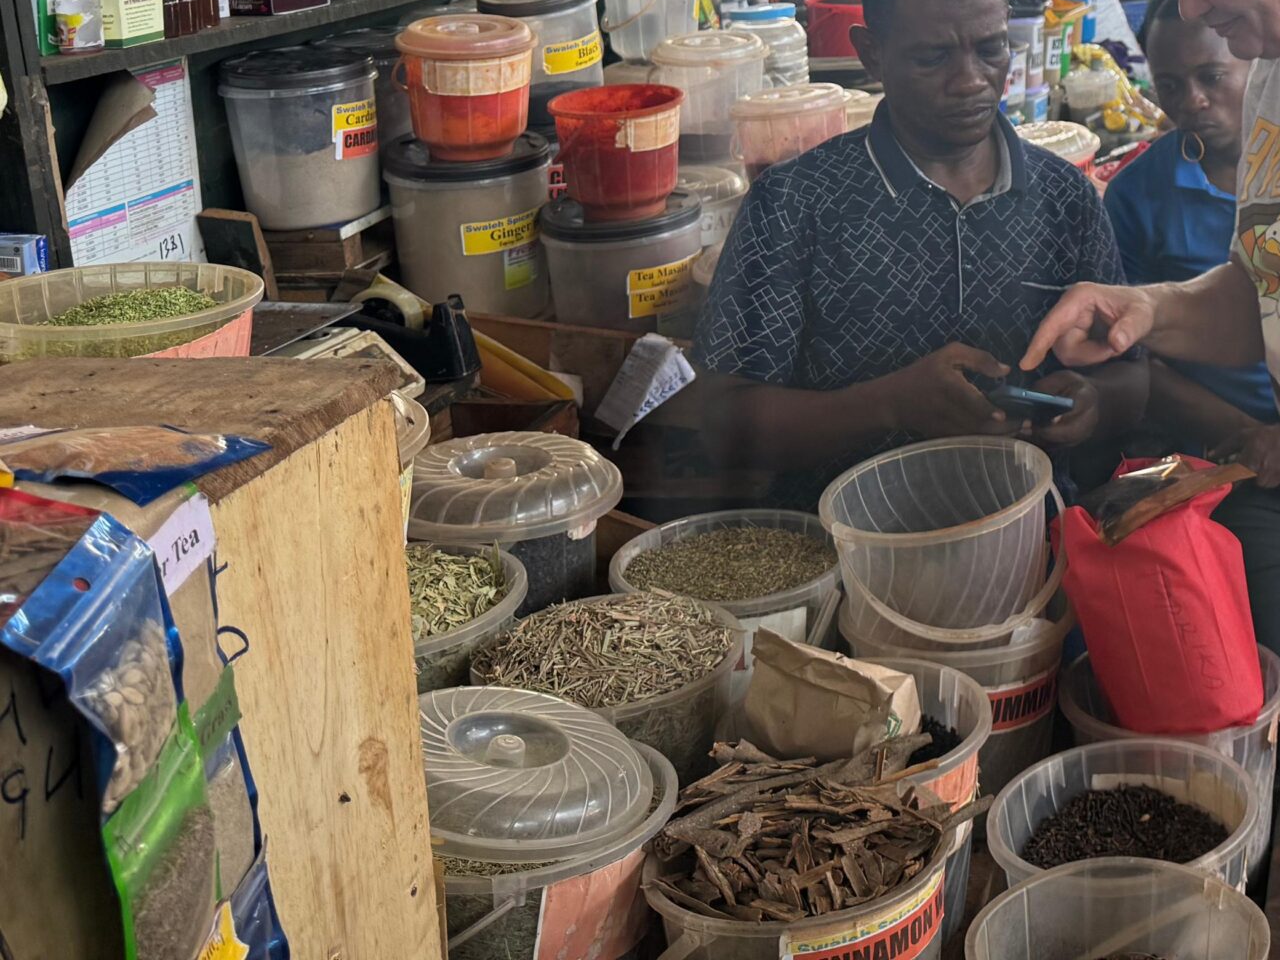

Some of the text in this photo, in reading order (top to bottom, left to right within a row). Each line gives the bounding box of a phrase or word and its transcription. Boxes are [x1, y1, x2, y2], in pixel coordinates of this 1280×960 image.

[466, 220, 504, 233] Swaleh
[490, 222, 532, 242] Ginger
[636, 271, 654, 281] Tea
[636, 293, 655, 303] Tea
[171, 528, 200, 563] Tea
